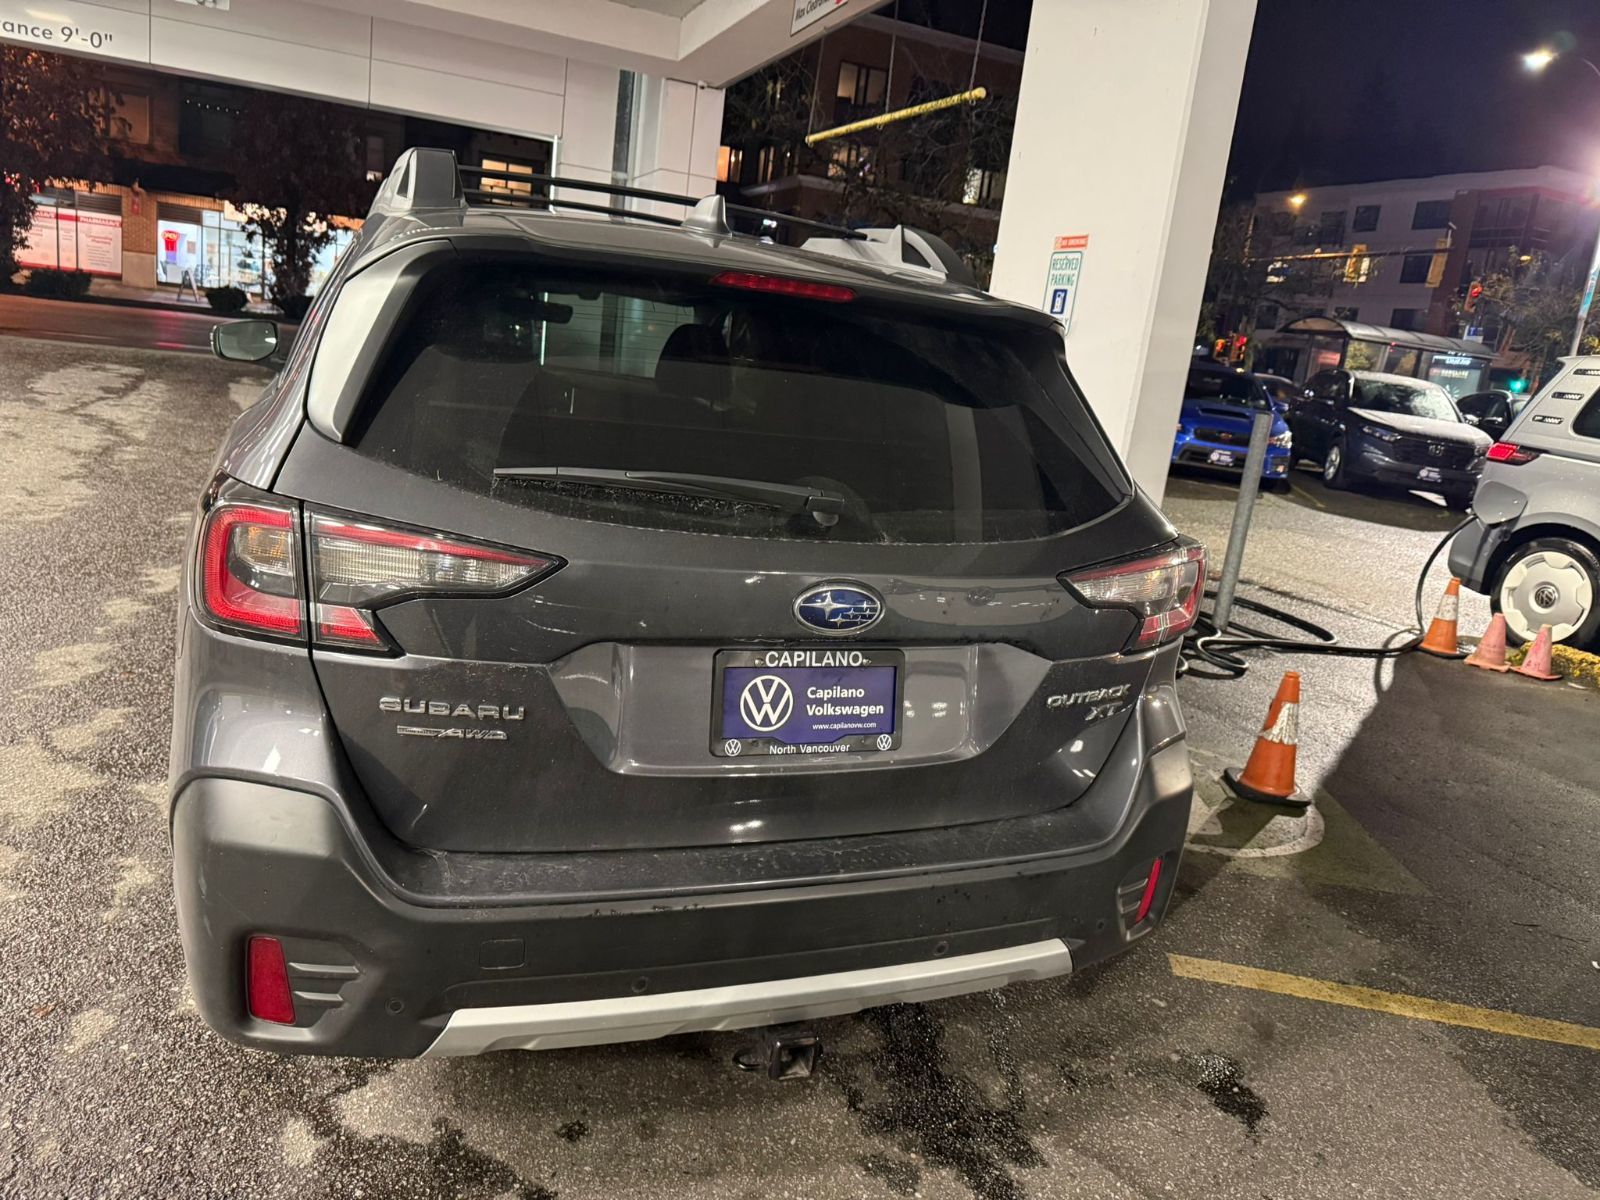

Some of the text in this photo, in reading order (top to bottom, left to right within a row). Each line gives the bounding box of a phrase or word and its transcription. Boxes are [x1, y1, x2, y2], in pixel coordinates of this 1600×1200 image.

[0, 20, 113, 48] ance 9'-0"
[1053, 257, 1080, 270] RESERVED
[1051, 273, 1075, 286] PARKING
[765, 650, 863, 668] CAPILANO
[807, 686, 865, 701] Capilano
[1047, 684, 1131, 708] OUTBACK
[379, 697, 525, 719] SUBARU
[806, 703, 884, 717] Volkswagen
[812, 722, 876, 730] www.capilanovw.com
[438, 727, 507, 740] AWD
[769, 743, 851, 755] North Vancouver
